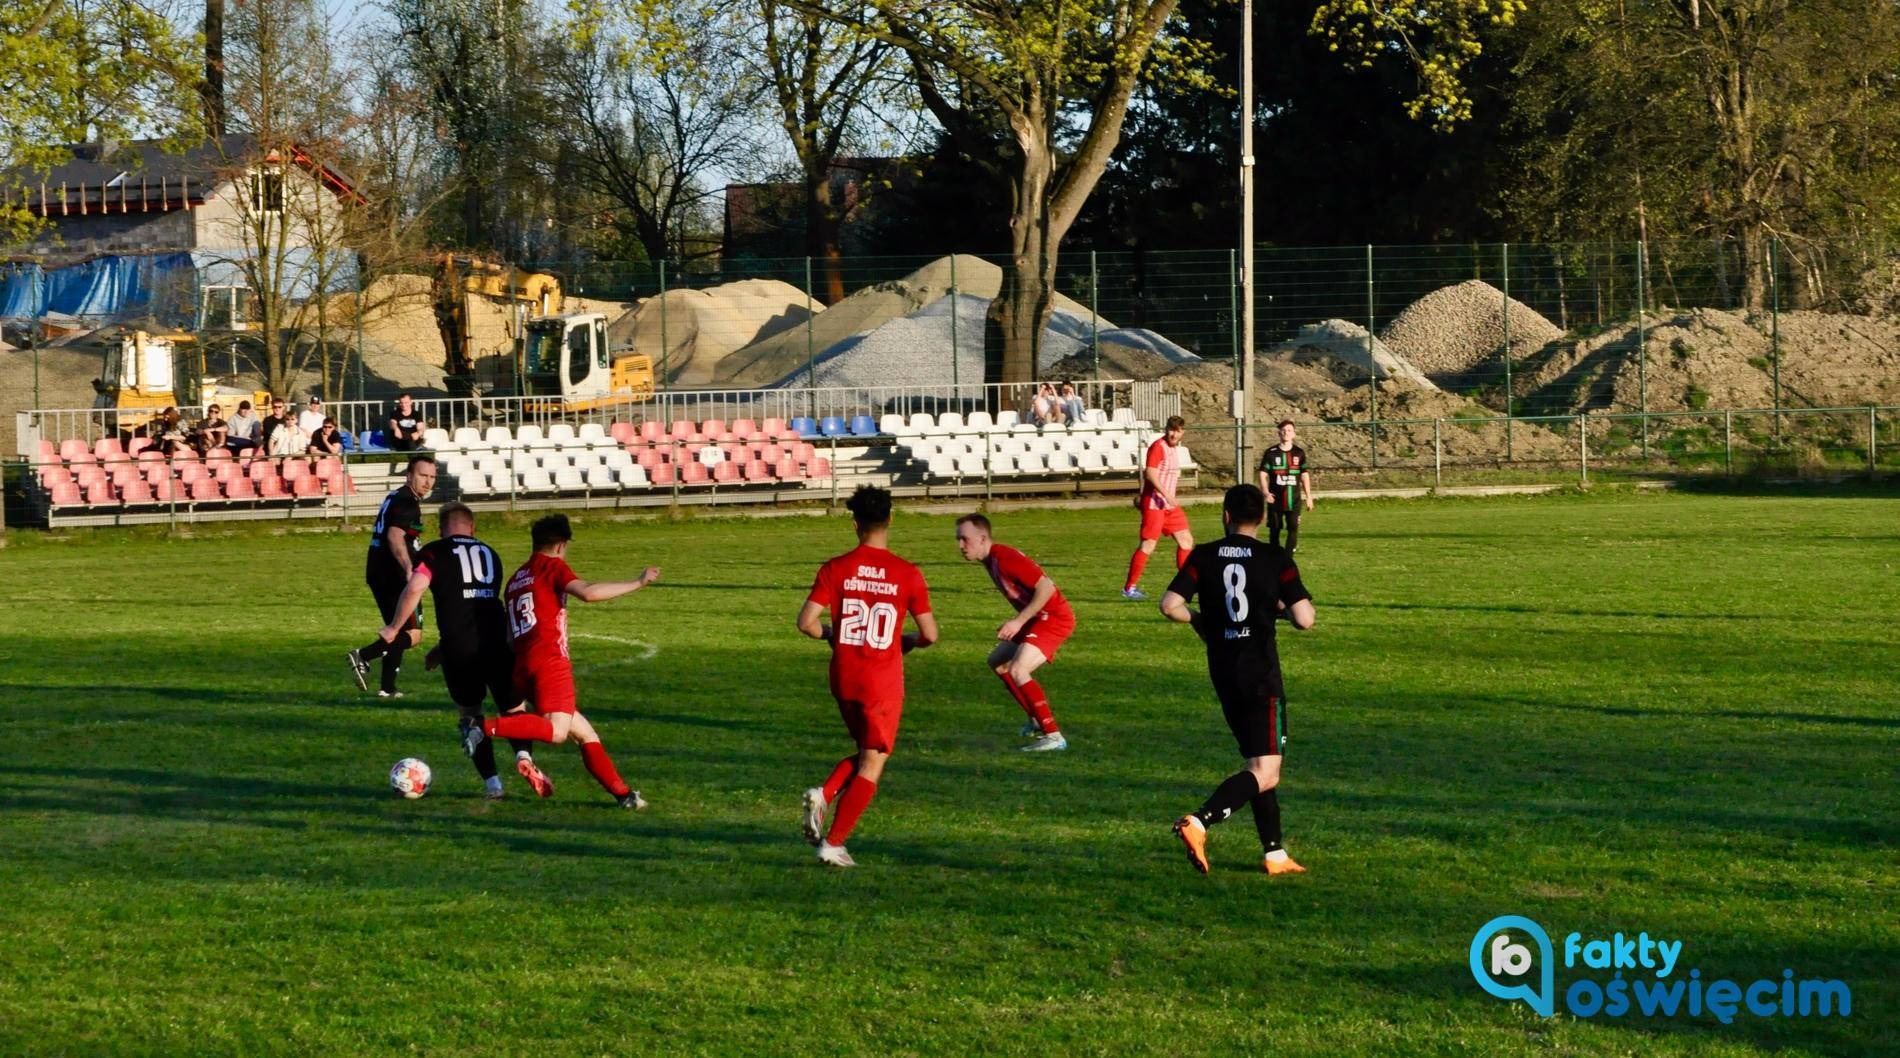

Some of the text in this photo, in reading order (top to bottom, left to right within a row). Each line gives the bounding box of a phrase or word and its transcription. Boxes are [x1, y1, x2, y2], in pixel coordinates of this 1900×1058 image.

[452, 545, 494, 584] 10
[843, 576, 899, 596] OŚWIĘCIM
[857, 565, 886, 580] SOŁA
[1223, 563, 1249, 622] 8
[509, 592, 537, 639] 13
[840, 598, 898, 650] 20
